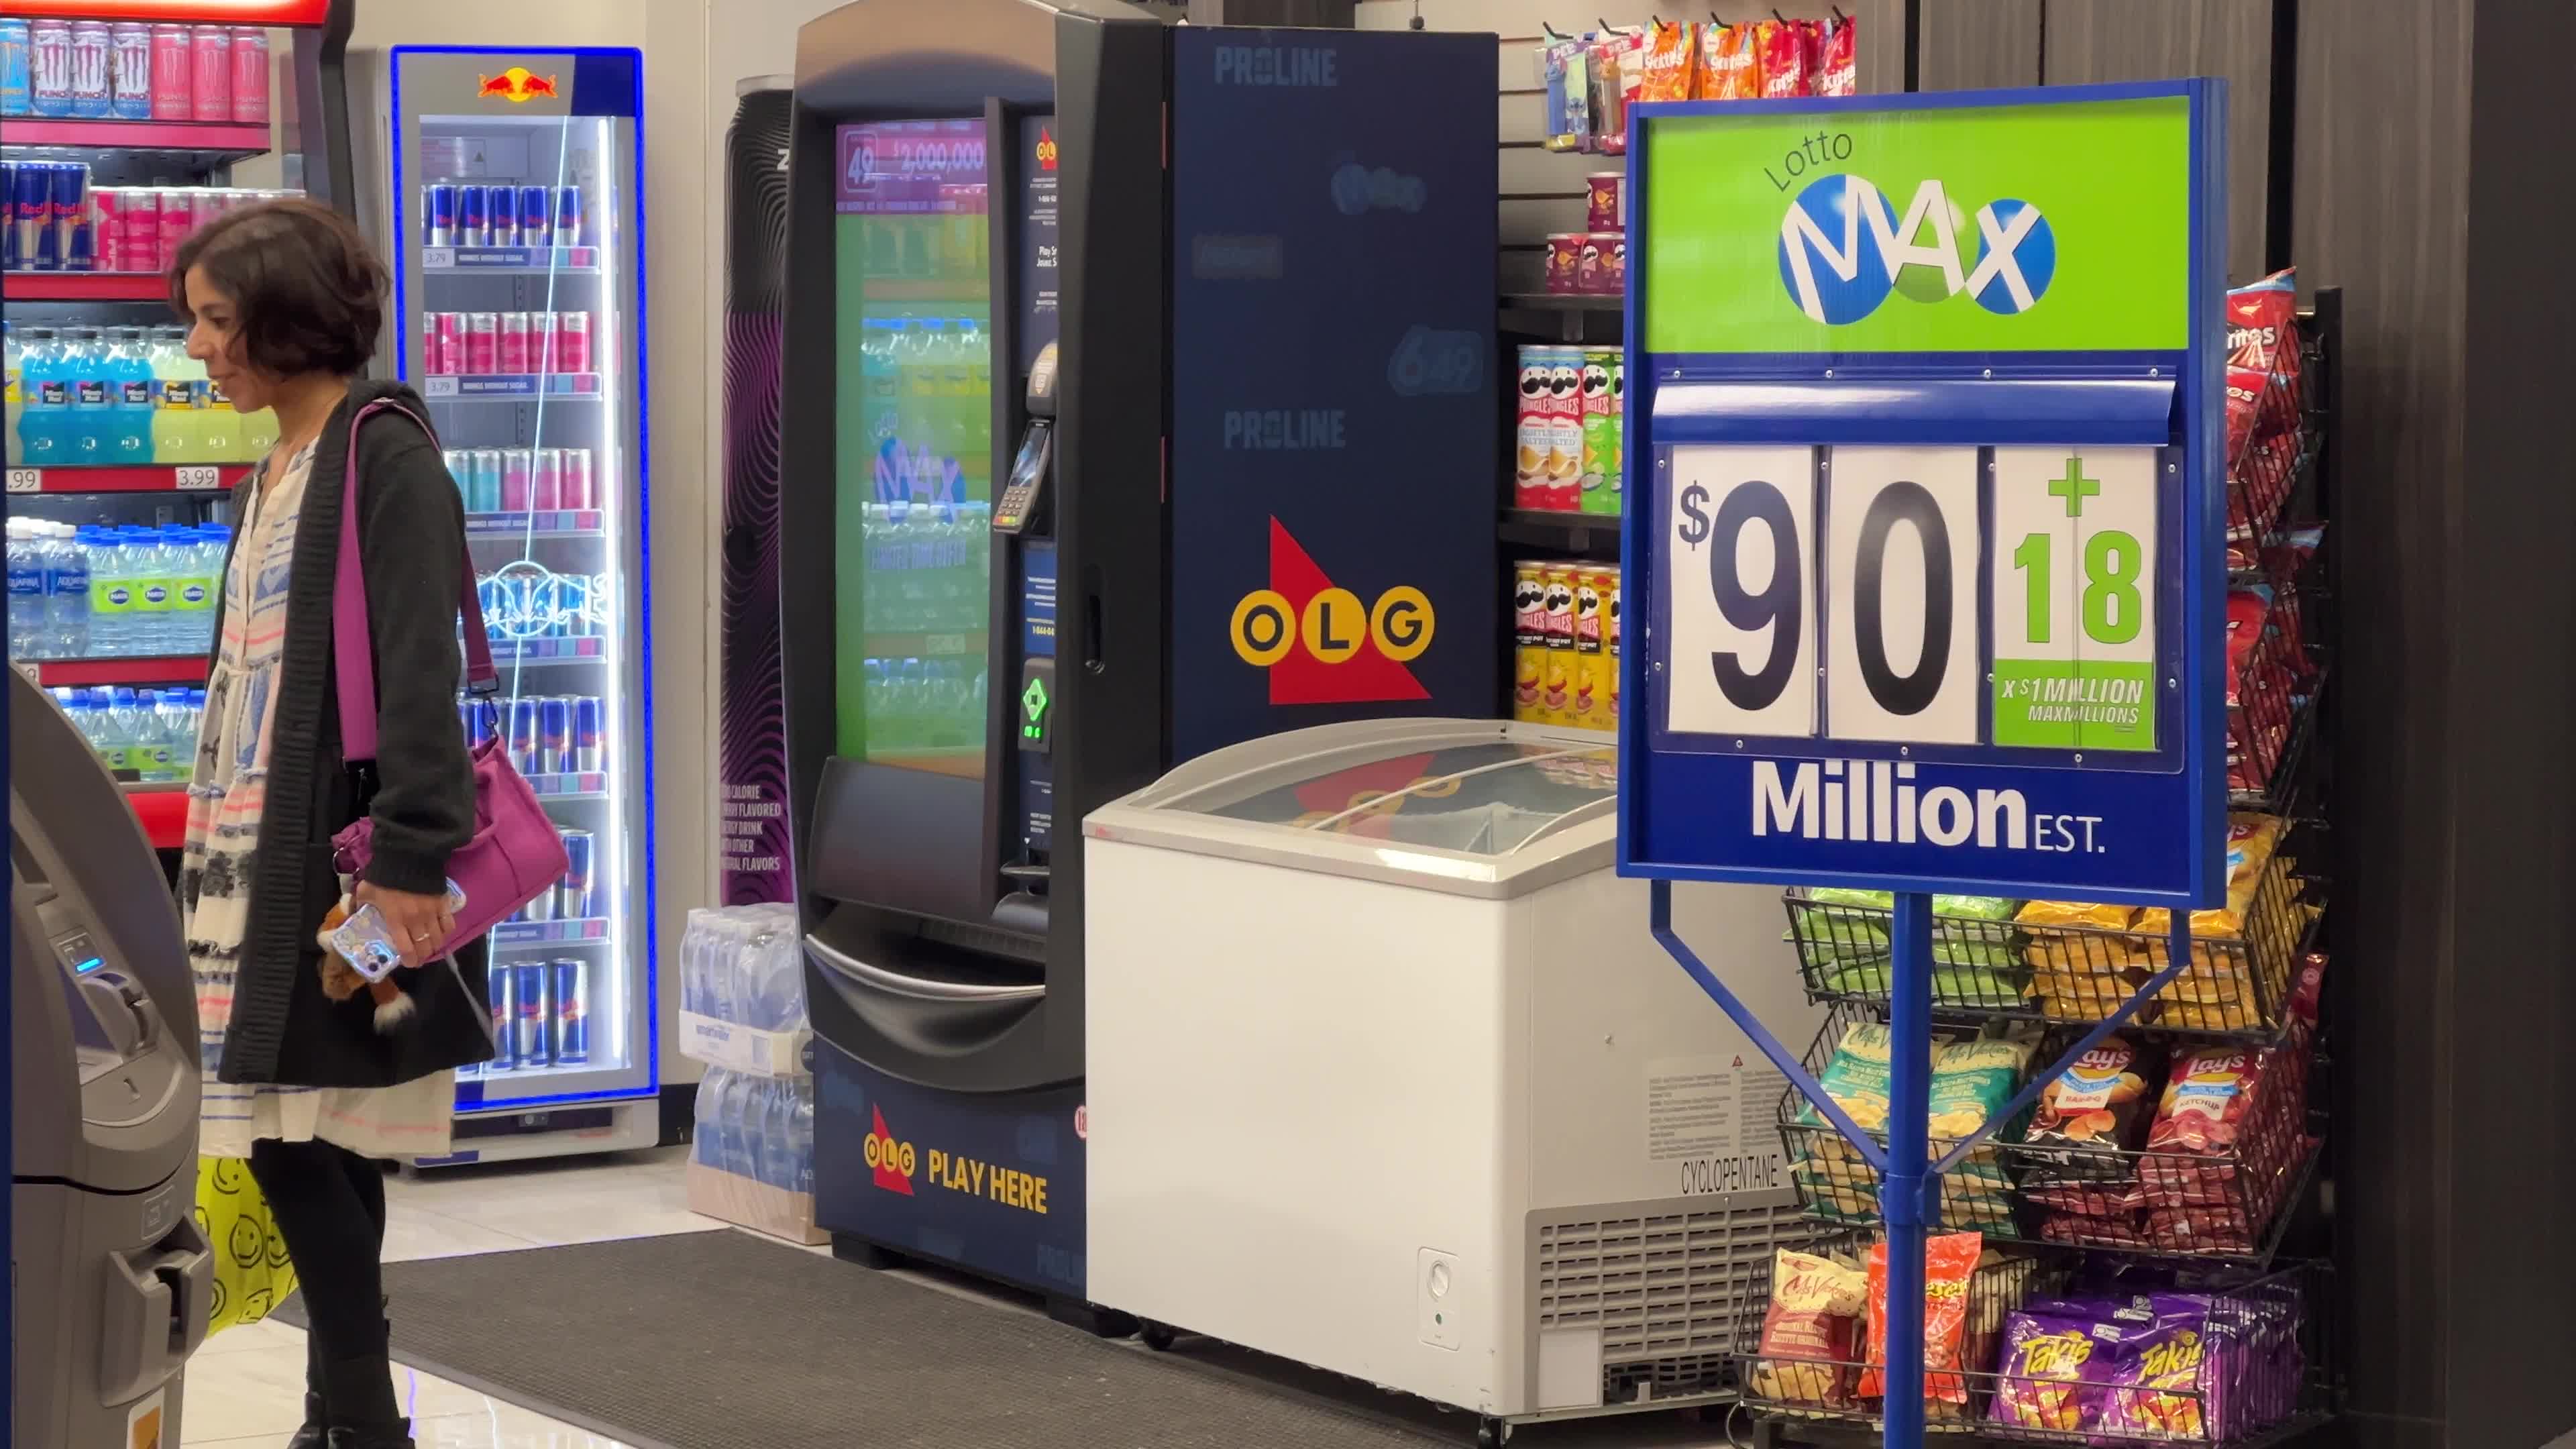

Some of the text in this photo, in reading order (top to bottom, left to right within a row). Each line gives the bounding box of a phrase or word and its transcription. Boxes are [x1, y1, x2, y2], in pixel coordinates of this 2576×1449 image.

[1215, 46, 1337, 87] PROLINE
[1764, 130, 1852, 193] Lotto
[1781, 174, 2042, 323] MAX
[2227, 327, 2275, 350] ritos
[431, 382, 450, 392] 3.79
[1224, 410, 1346, 449] PROLINE
[7, 471, 36, 488] .99
[179, 470, 215, 486] 3.99
[8, 577, 40, 588] QUAFINA
[2014, 531, 2141, 644] 18
[1242, 600, 1423, 652] OLG
[2028, 705, 2139, 724] MAXMILLIONS
[739, 803, 782, 817] FLAVORED
[1752, 760, 2105, 853] Million EST.
[742, 857, 780, 871] FLAVORS
[867, 1138, 1047, 1214] OLG PLAY HERE
[1681, 1154, 1778, 1195] CYCLOPENTANE
[2021, 1339, 2094, 1376] Takis
[2139, 1340, 2206, 1381] Takis
